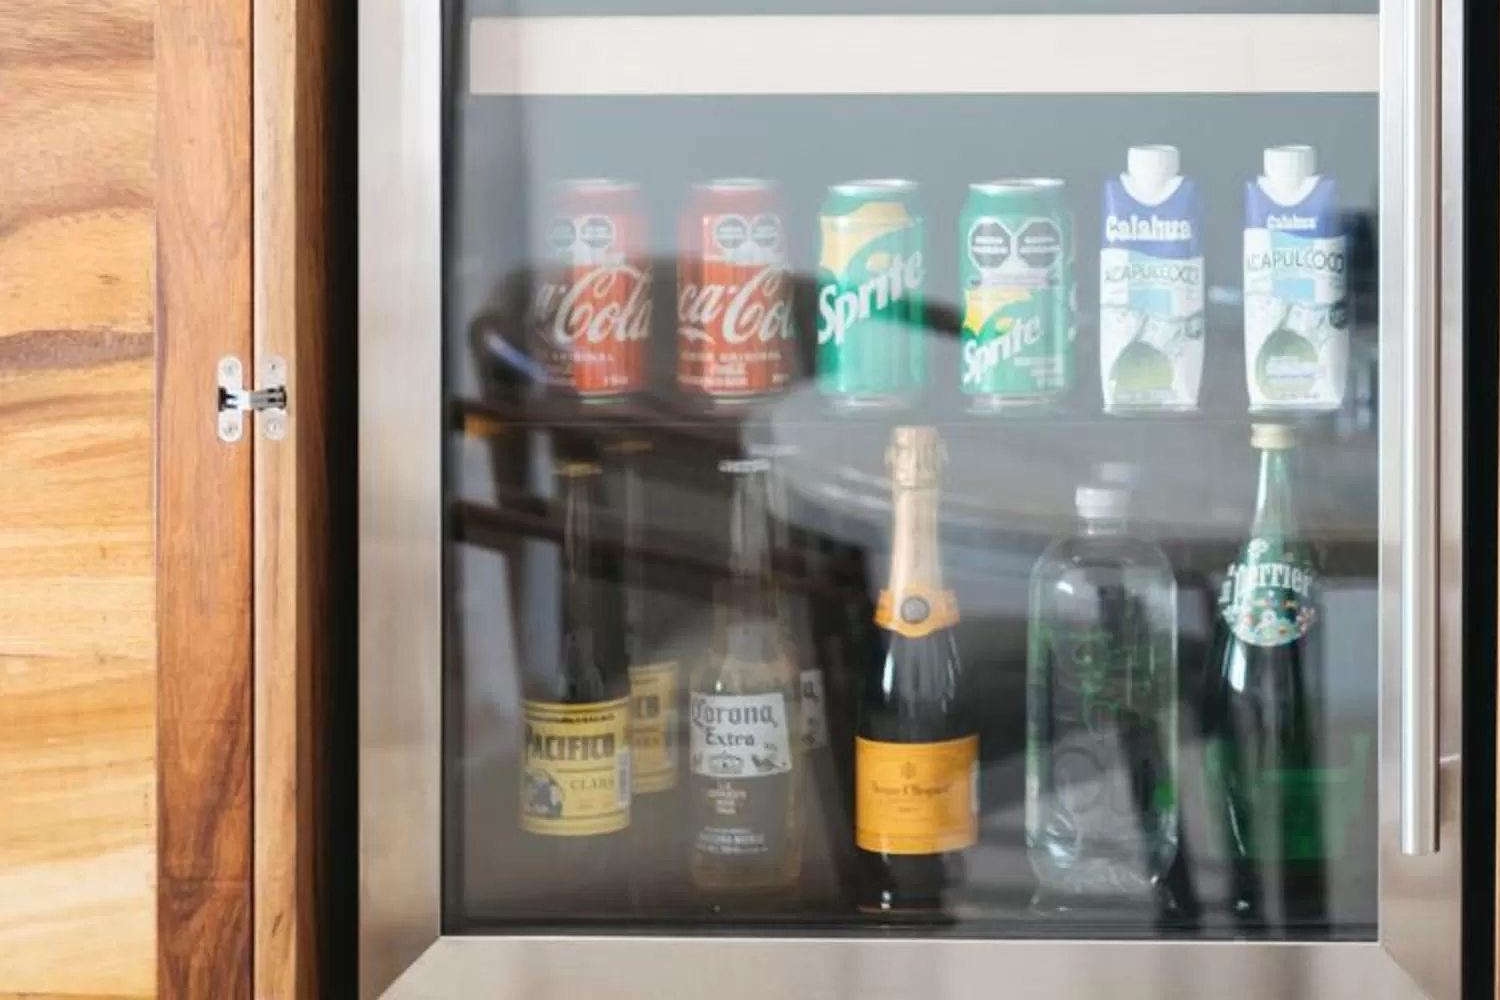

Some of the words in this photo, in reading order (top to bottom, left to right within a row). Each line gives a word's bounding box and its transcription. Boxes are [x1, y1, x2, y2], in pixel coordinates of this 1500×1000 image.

[535, 265, 652, 346] a-Cola
[817, 250, 925, 345] Sprite
[963, 315, 1042, 385] Sprite
[691, 697, 780, 728] Corona
[705, 728, 756, 748] Extra
[524, 724, 616, 763] PACIFICO
